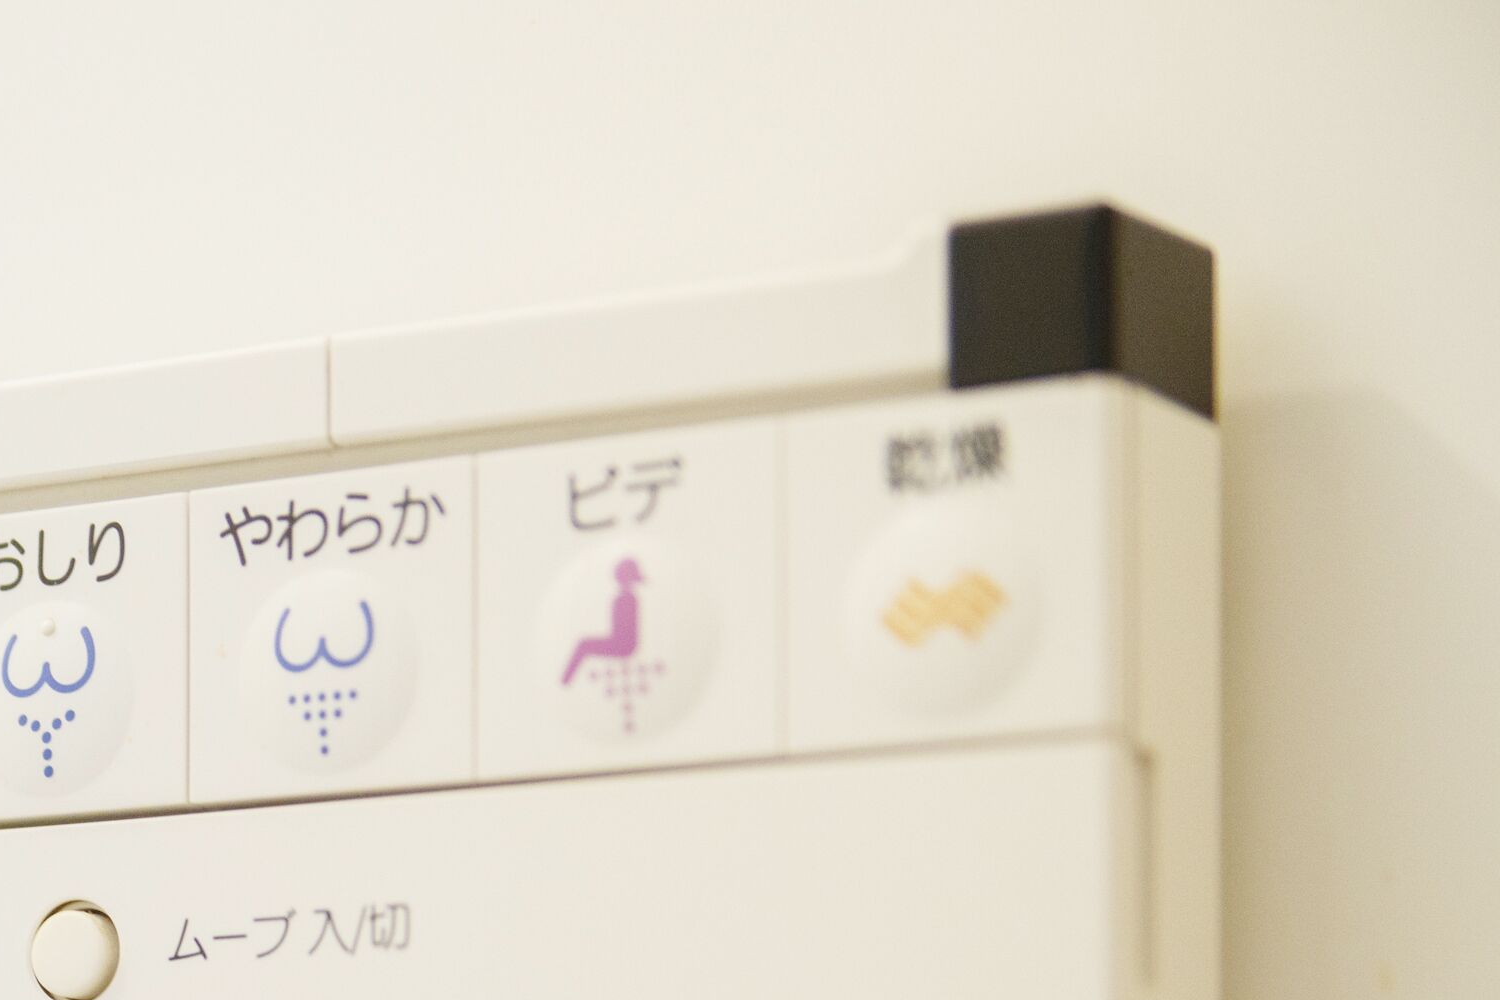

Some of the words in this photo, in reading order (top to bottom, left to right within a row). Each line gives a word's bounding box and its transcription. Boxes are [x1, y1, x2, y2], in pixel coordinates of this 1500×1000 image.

[219, 487, 446, 566] やわらか
[167, 907, 297, 961] ムーブ
[308, 902, 411, 956] 入/切
